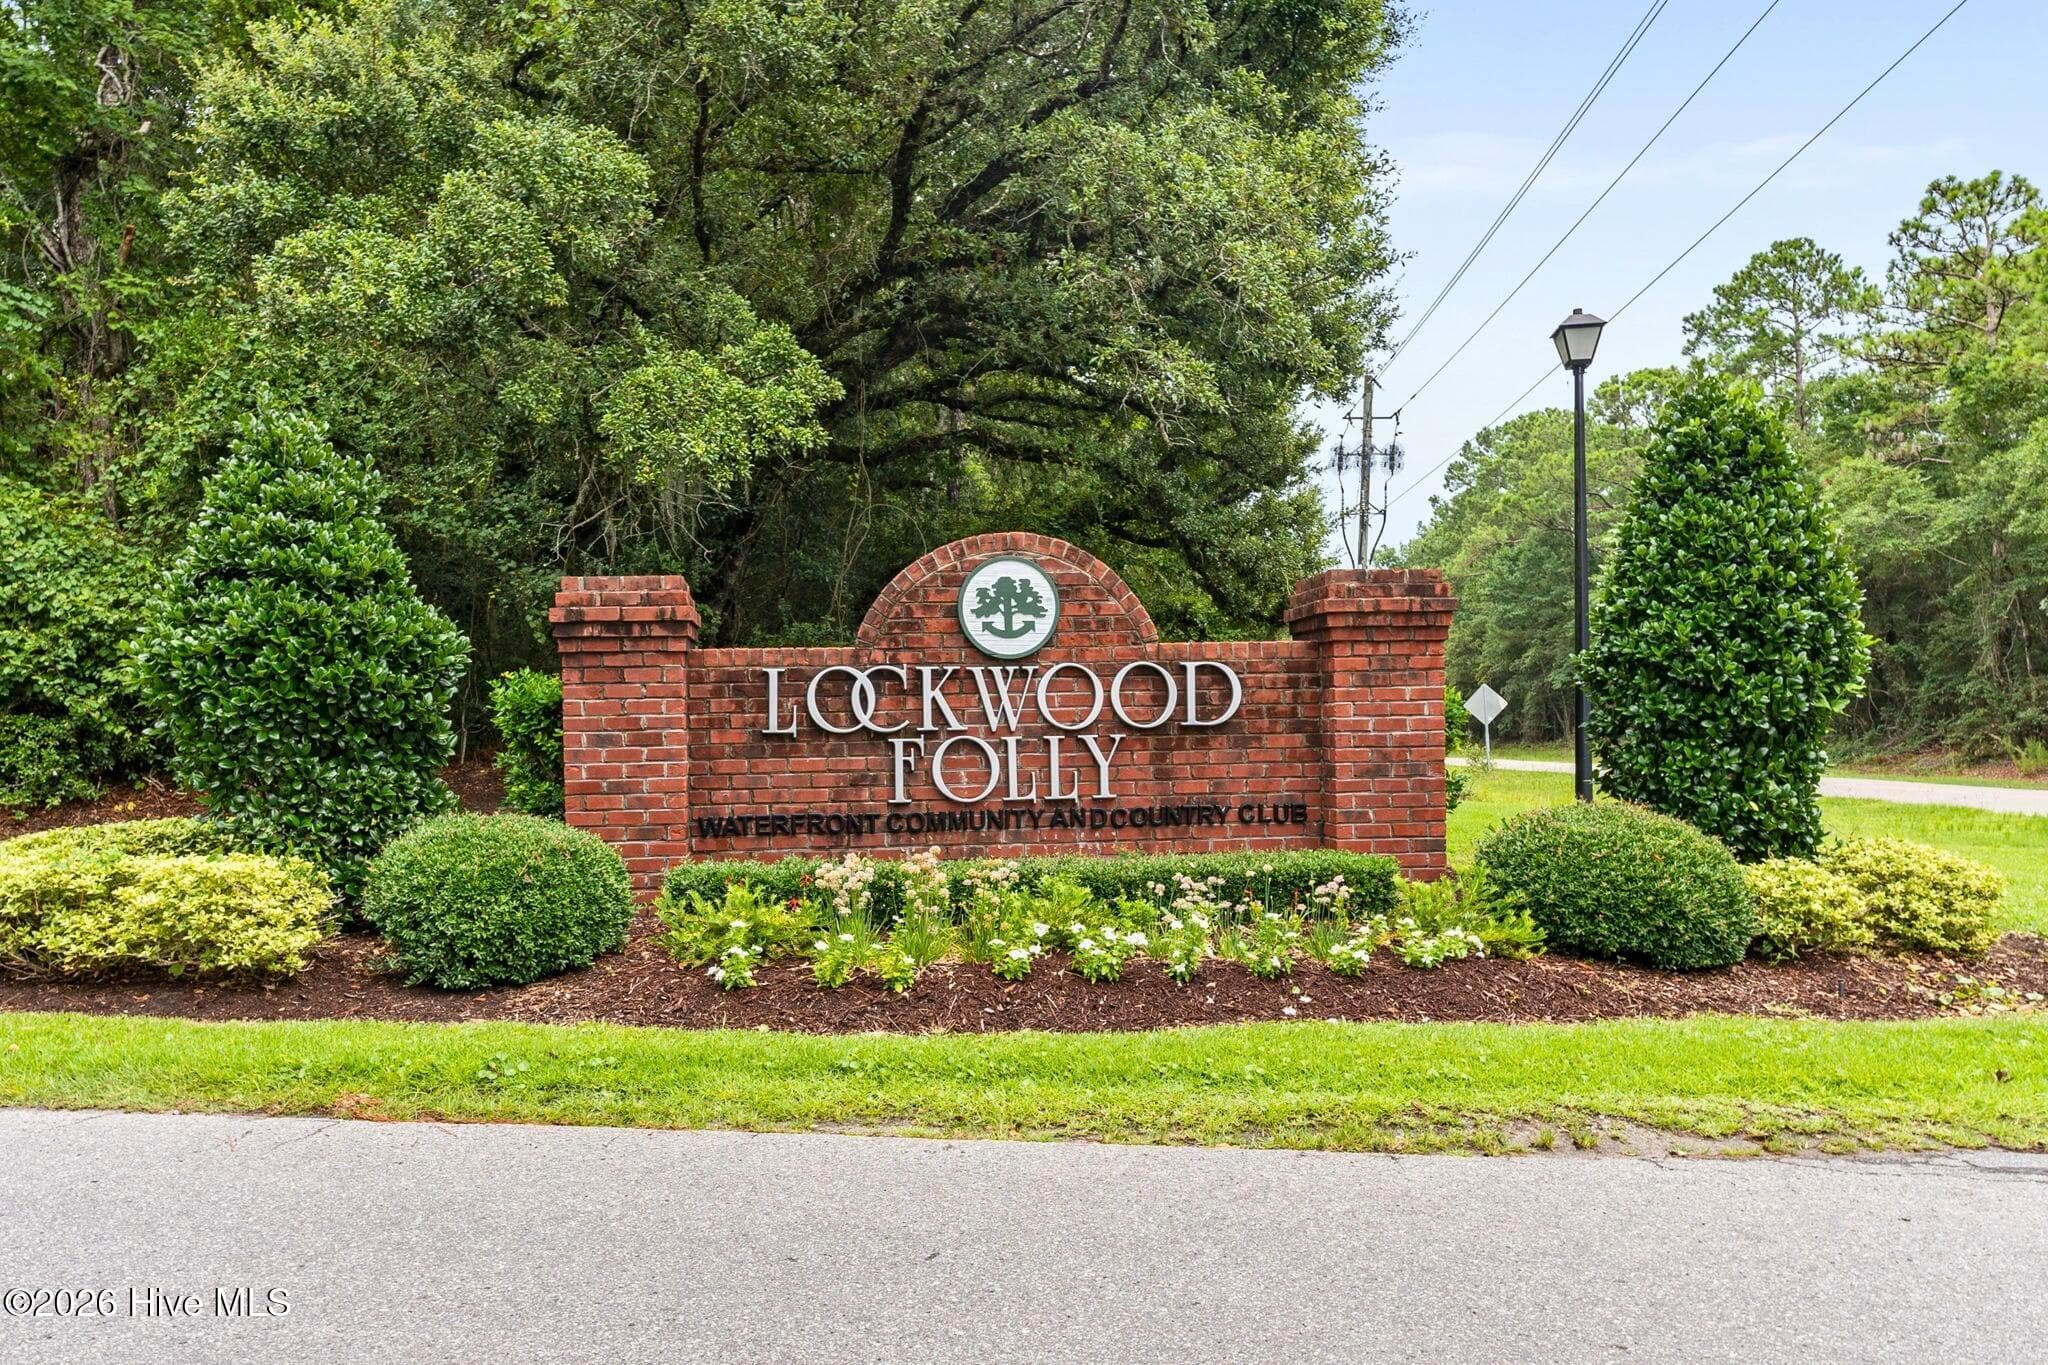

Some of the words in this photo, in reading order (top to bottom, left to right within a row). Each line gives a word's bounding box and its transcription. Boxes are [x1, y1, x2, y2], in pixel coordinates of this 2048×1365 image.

[762, 661, 1243, 737] LOCKWOOD
[887, 734, 1126, 804] FOLLY
[699, 813, 881, 837] WATERFRONT
[886, 808, 1044, 834] COMMUNITY
[1050, 808, 1107, 829] AND
[1110, 805, 1231, 828] COUNTRY
[1238, 803, 1308, 824] CLUB
